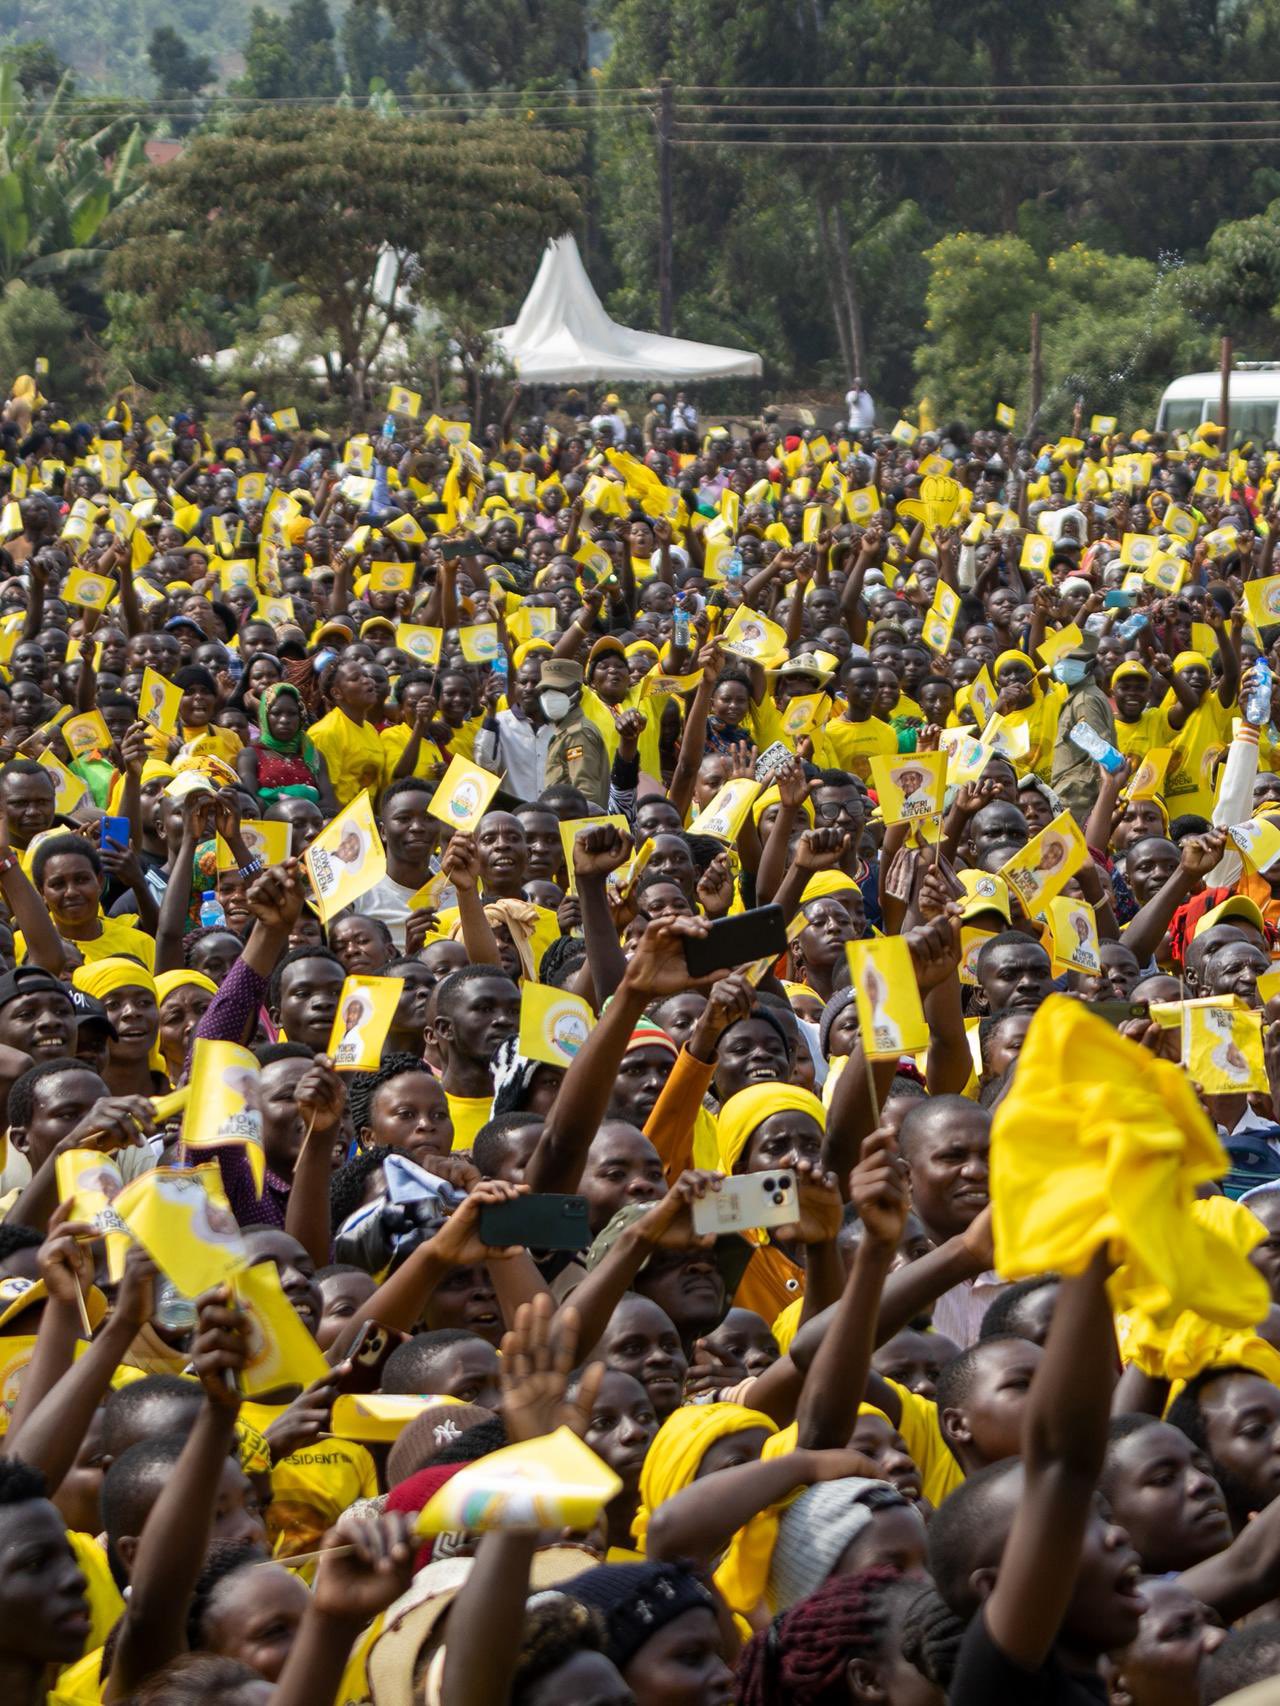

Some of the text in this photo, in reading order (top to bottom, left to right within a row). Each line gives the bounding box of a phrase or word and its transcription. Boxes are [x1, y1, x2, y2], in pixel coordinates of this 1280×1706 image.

[309, 846, 329, 894] MUSEVENI
[316, 846, 335, 886] YOWERI
[282, 1453, 339, 1465] ESIDENT
